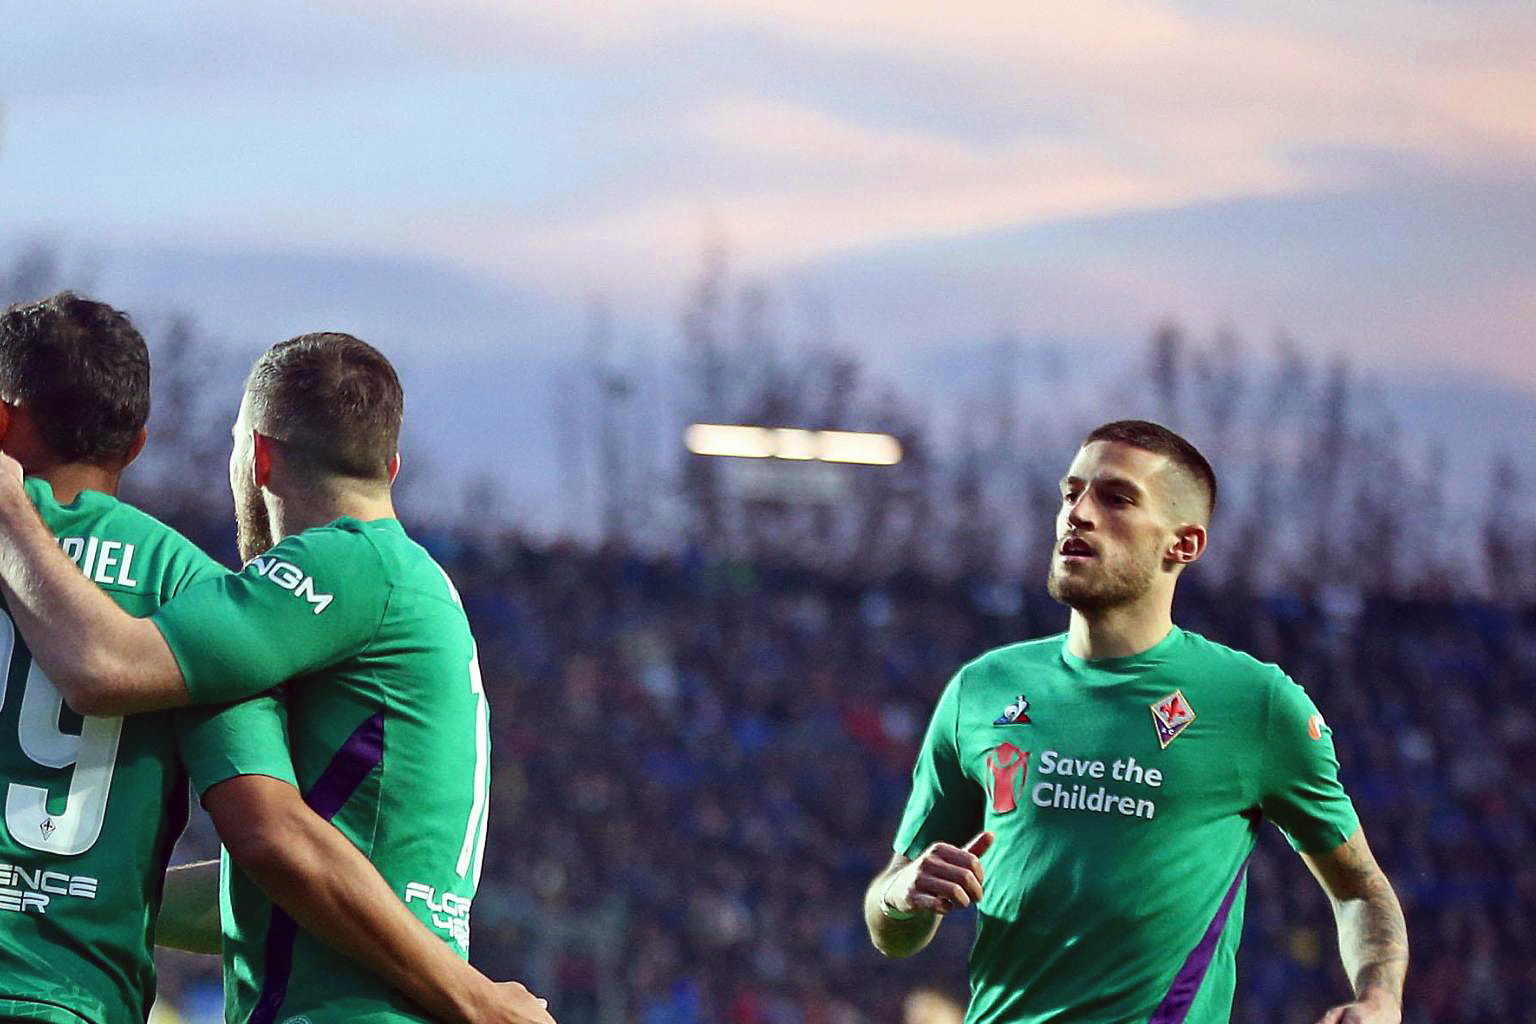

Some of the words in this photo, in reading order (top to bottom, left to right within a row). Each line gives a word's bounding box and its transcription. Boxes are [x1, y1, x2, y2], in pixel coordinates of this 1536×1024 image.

[56, 535, 137, 587] RIEL
[1037, 749, 1105, 779] Save
[1112, 756, 1163, 787] the
[1031, 781, 1156, 820] Children
